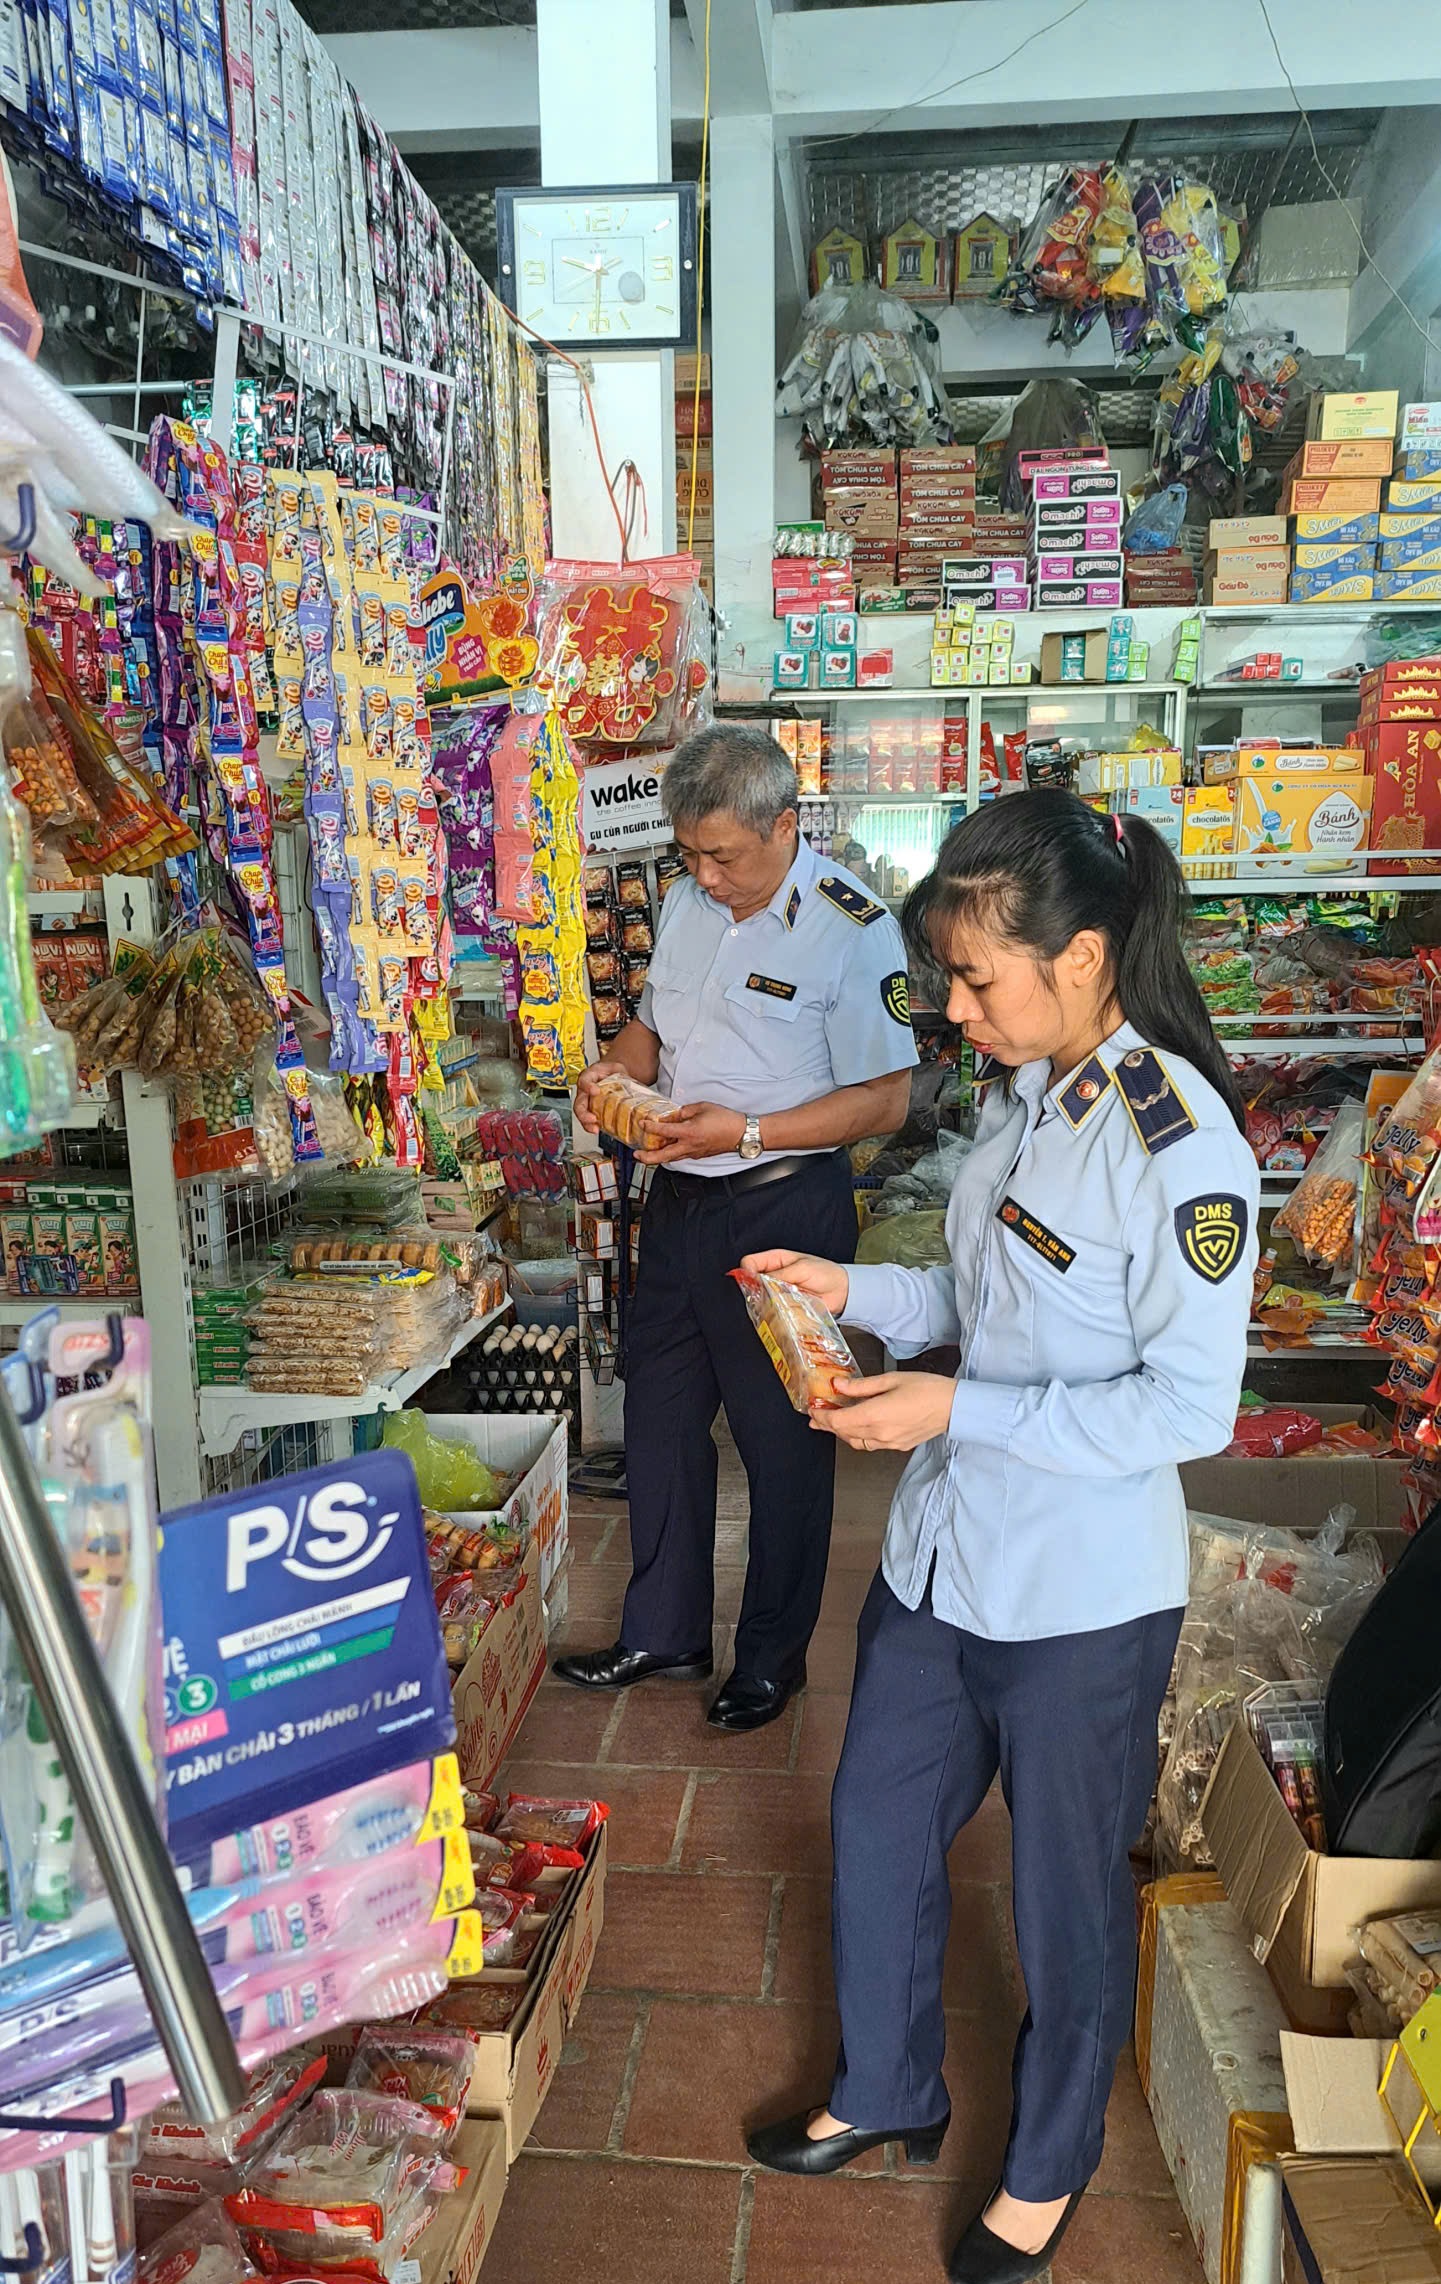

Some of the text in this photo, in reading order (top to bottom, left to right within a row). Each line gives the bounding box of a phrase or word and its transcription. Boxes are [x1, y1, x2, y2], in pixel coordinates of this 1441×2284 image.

[651, 255, 673, 281] 3
[847, 465, 867, 474] CHUA
[869, 464, 884, 473] CAY
[929, 463, 950, 471] CHUA
[950, 462, 966, 470] CAY
[1076, 477, 1117, 489] Omachi
[929, 488, 949, 497] CHUA
[949, 488, 965, 497] CAY
[916, 501, 947, 510] KOKOMI
[832, 507, 865, 517] KOKOMI
[1041, 510, 1080, 521] Omachi
[929, 514, 950, 523] CHUA
[950, 514, 966, 523] CAY
[989, 528, 1010, 536] CHUA
[1010, 528, 1025, 536] CAY
[855, 541, 872, 549] HUA
[926, 540, 947, 548] CHUA
[948, 540, 963, 548] CAY
[1039, 535, 1080, 548] Omachi
[946, 565, 986, 579] Omachi
[1079, 560, 1119, 572] Omachi
[1042, 589, 1080, 601] Omachi
[1406, 729, 1420, 760] AN
[1171, 791, 1182, 799] 24
[1314, 806, 1360, 829] Bánh
[590, 830, 602, 840] GU
[1371, 1124, 1422, 1155] Jelly
[1194, 1203, 1233, 1221] DMS
[1377, 1311, 1430, 1343] Jelly
[186, 1680, 209, 1709] 3
[174, 1722, 209, 1750] MẠI
[177, 1752, 223, 1786] BÀN
[277, 1722, 295, 1746] 3
[371, 1691, 382, 1711] 1
